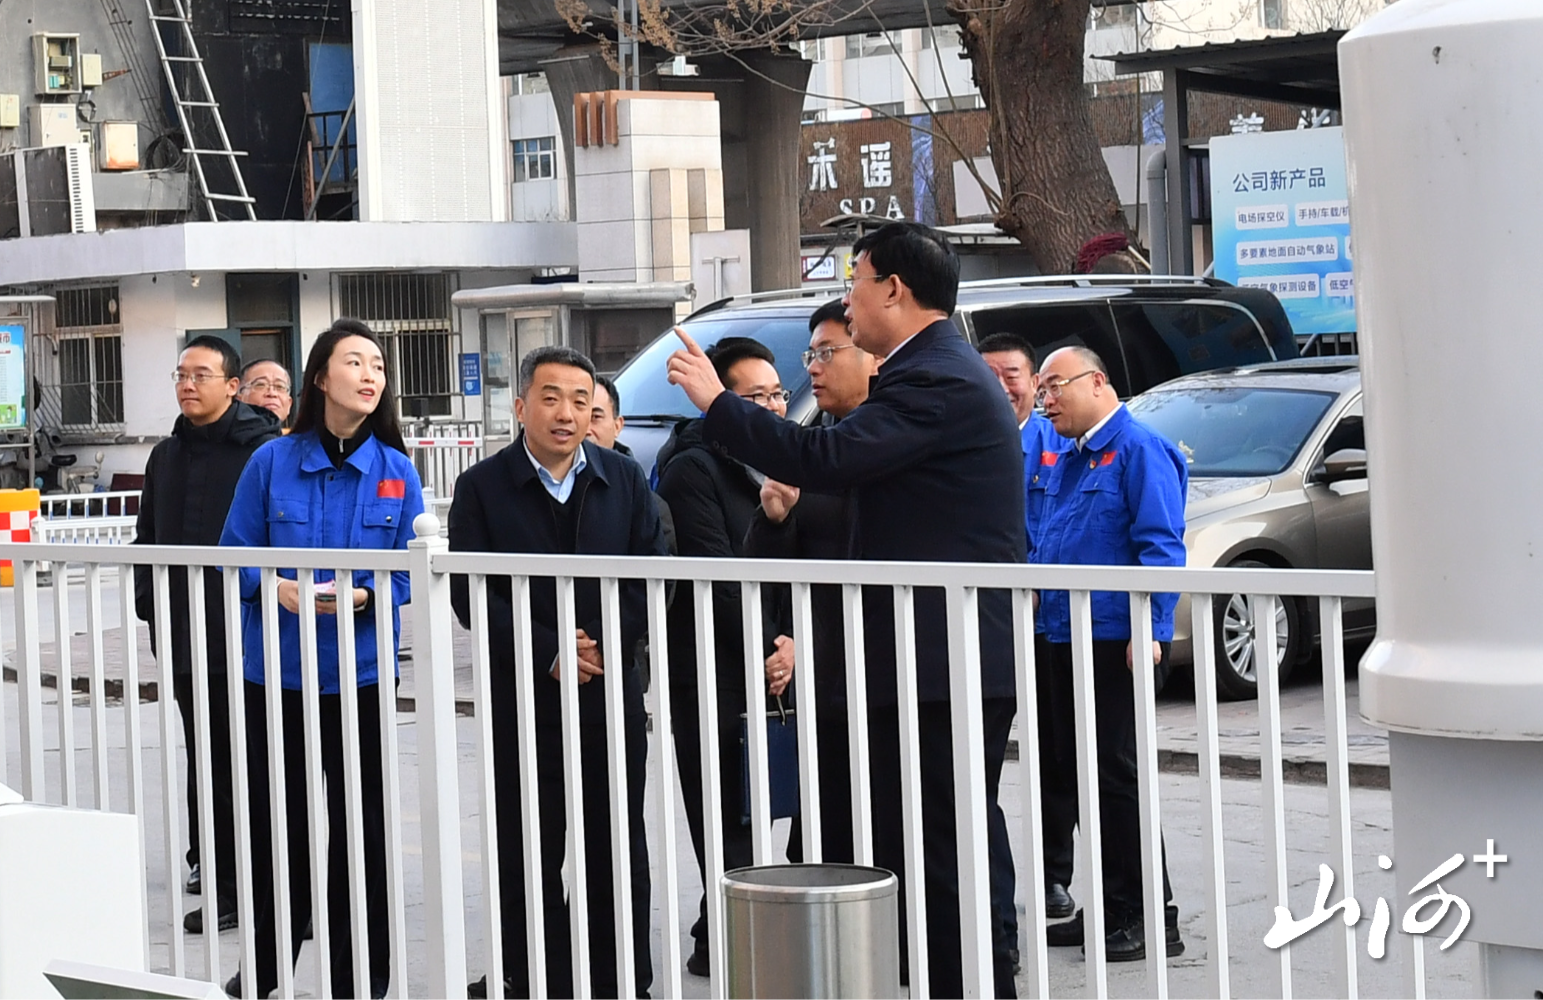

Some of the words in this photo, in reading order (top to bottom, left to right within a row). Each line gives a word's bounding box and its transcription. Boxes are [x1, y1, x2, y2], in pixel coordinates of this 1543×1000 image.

[1233, 167, 1326, 193] 公司新产品
[839, 195, 905, 219] SPA
[1238, 211, 1285, 224] 电场探空仪
[1240, 243, 1335, 259] 多要素地面自动气象站
[1242, 280, 1317, 293] 气象探测设备
